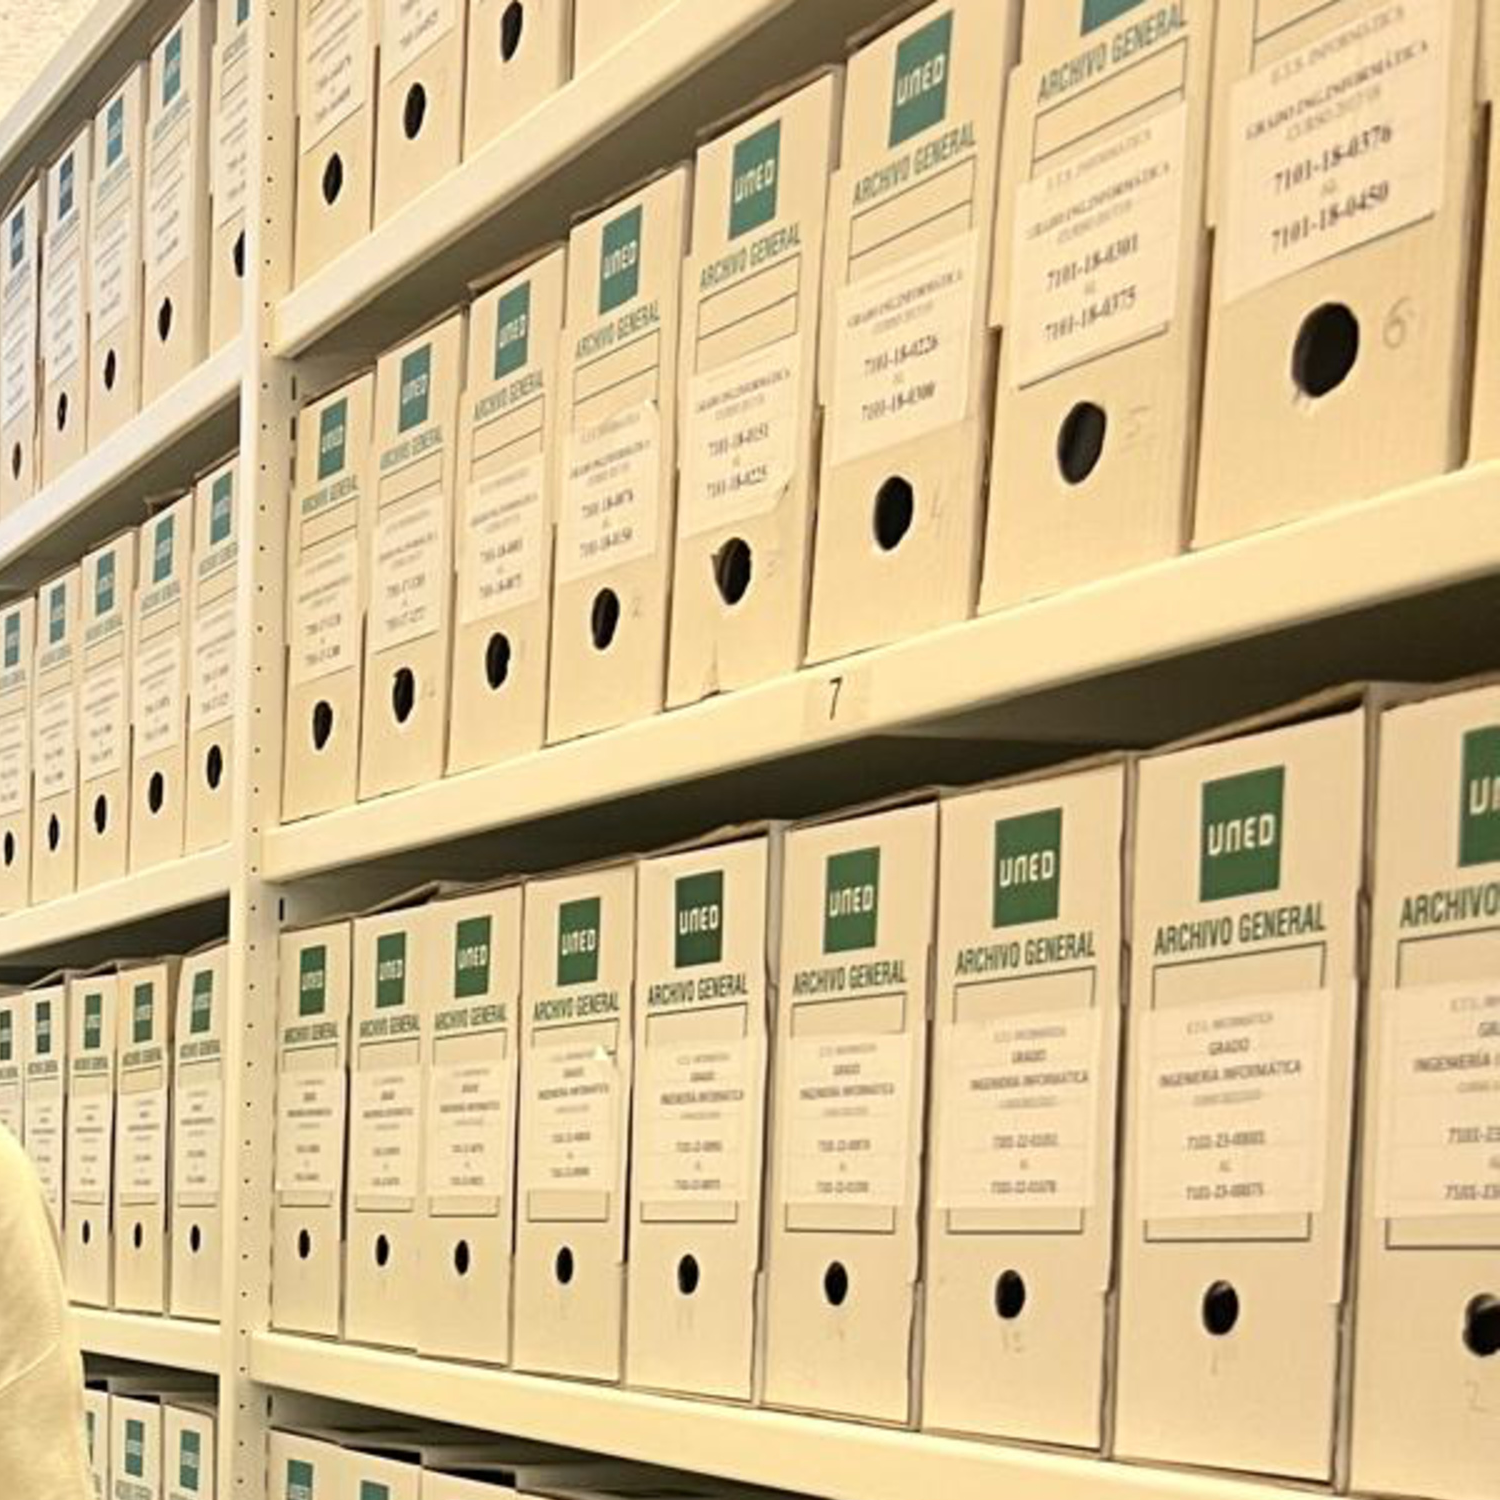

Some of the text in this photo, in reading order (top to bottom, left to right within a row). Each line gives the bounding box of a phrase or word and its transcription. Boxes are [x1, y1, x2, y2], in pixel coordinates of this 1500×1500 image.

[1038, 3, 1185, 103] ARCHIVO GENERAL
[896, 53, 946, 107] UNED
[733, 158, 775, 207] UNED
[853, 120, 976, 205] ARCHIVO GENERAL
[602, 239, 638, 282] UNED
[699, 222, 801, 291] ARCHIVO GENERAL
[575, 298, 661, 361] ARCHIVO GENERAL
[1382, 296, 1414, 350] 6
[829, 675, 843, 721] 7
[1207, 813, 1276, 857] UNED
[998, 849, 1056, 889] UNED
[680, 904, 719, 936] UNED
[828, 884, 875, 918] UNED
[1399, 881, 1500, 928] ARCHIVO
[560, 929, 597, 957] UNED
[1154, 901, 1326, 957] ARCHIVO GENERAL
[955, 930, 1096, 976] ARCHIVO GENERAL
[647, 971, 748, 1009] ARCHIVO GENERAL
[792, 959, 907, 998] ARCHIVO GENERAL
[533, 990, 620, 1023] ARCHIVO GENERAL
